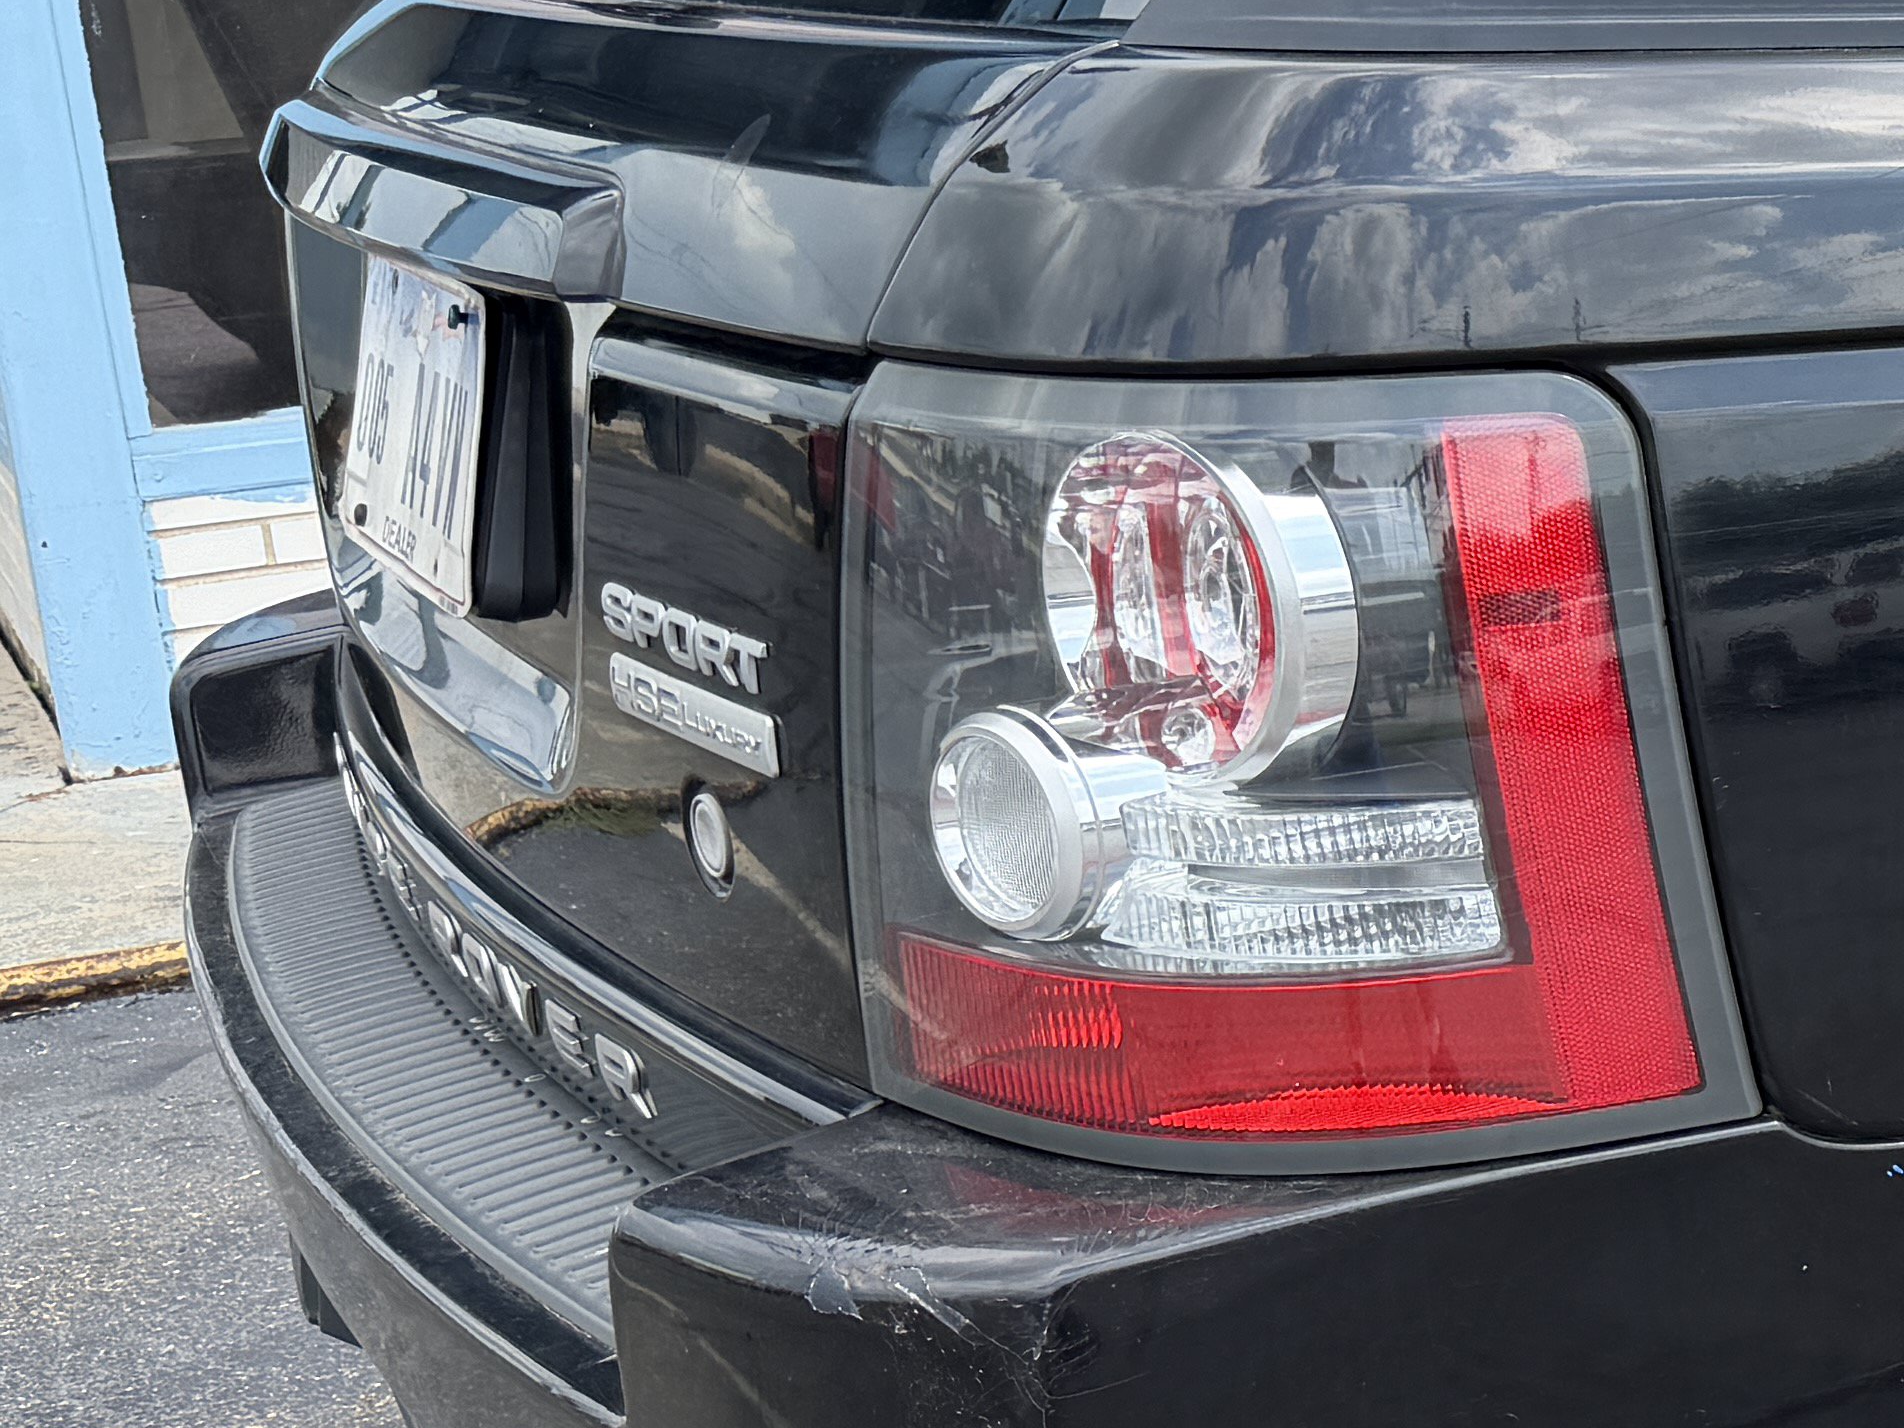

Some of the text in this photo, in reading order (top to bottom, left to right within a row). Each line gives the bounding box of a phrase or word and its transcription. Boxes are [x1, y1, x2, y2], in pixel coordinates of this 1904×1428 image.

[382, 514, 418, 565] DEALER
[600, 581, 769, 695] SPORT
[613, 666, 762, 756] HSE LUXURY
[427, 899, 660, 1120] ROVER
